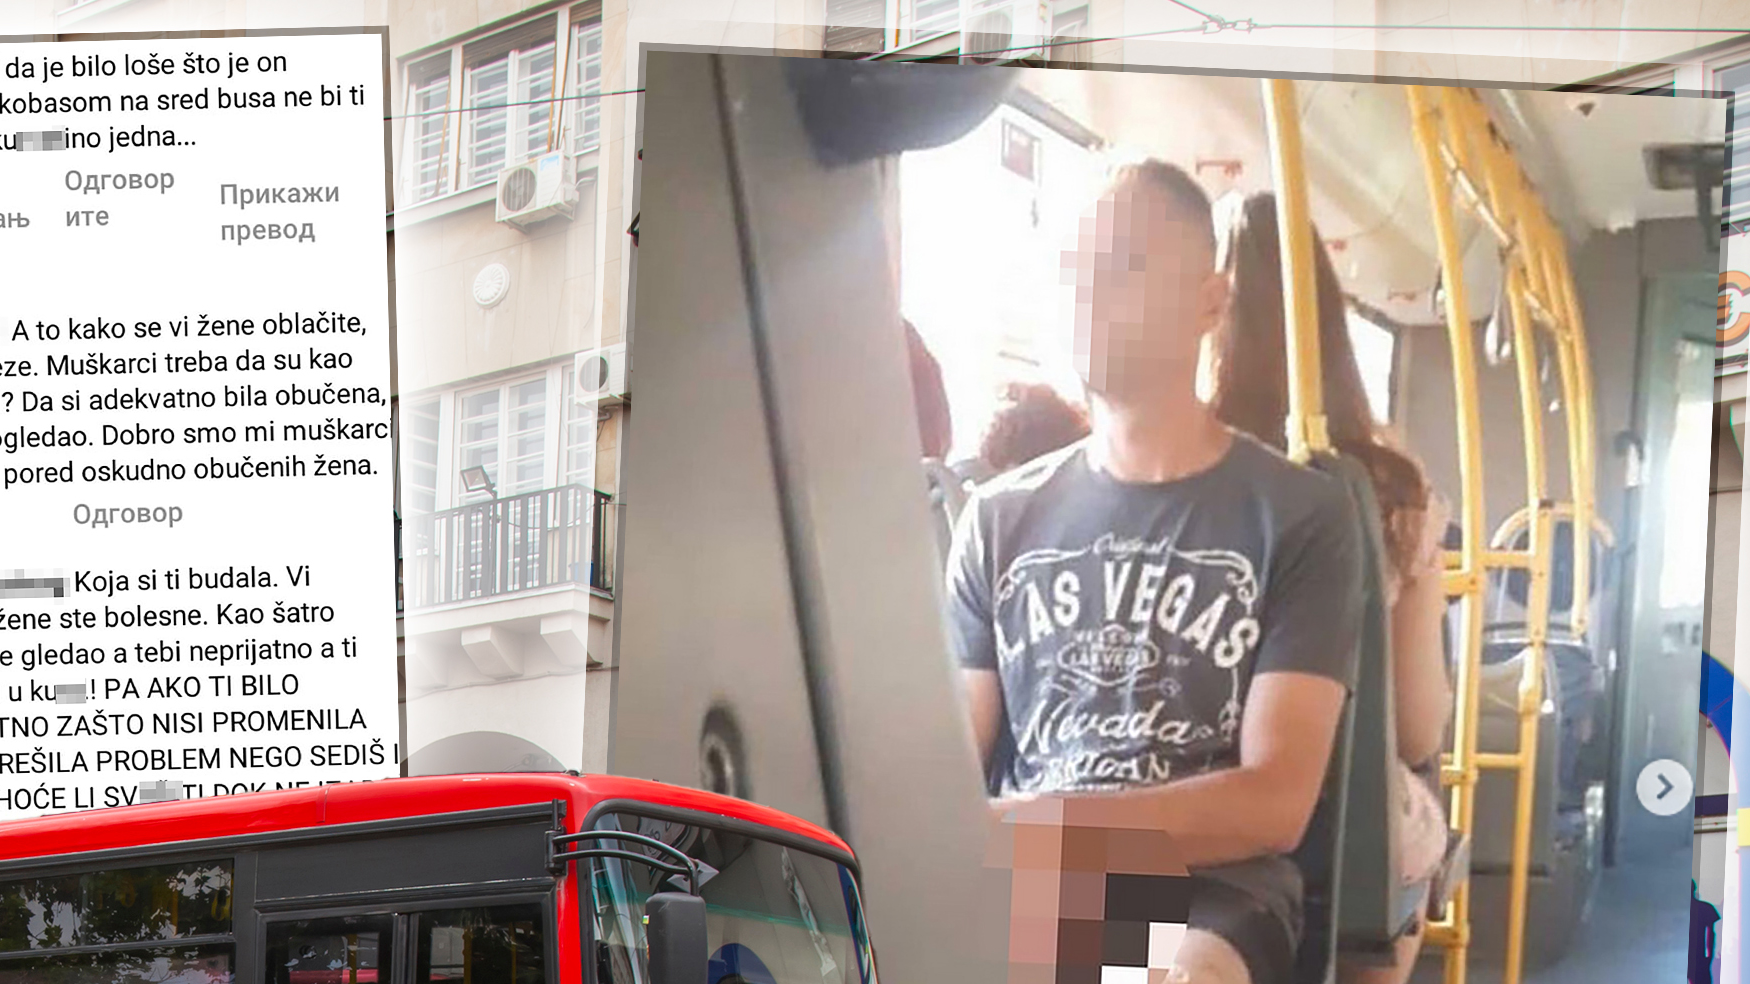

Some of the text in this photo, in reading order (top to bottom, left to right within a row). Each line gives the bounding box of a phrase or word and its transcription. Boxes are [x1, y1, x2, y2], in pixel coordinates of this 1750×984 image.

[994, 560, 1259, 668] LAS VEGAS
[1018, 700, 1192, 754] Nevada
